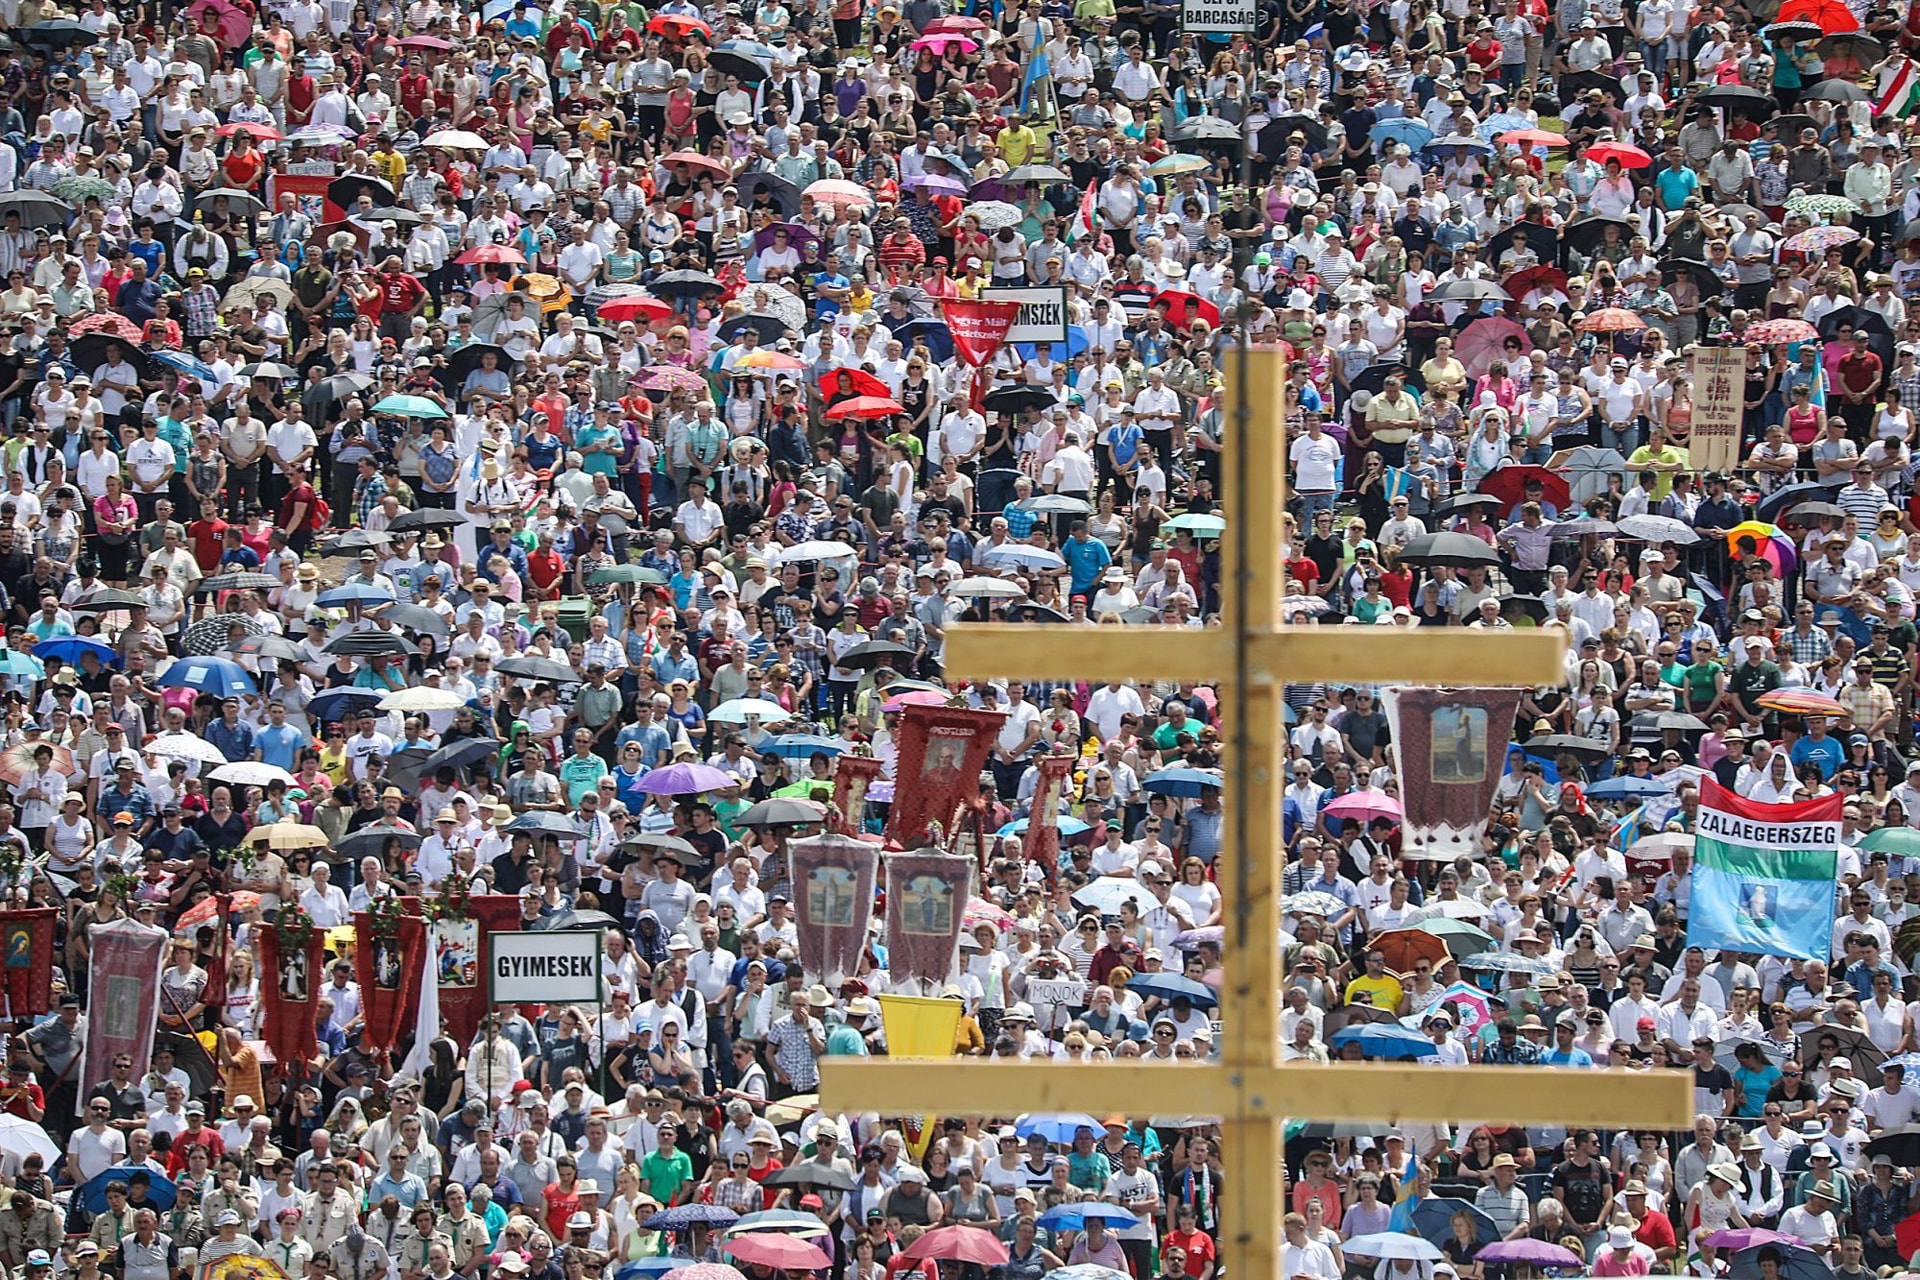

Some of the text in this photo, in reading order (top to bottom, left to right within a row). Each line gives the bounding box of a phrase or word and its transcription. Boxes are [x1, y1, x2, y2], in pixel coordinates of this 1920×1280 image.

[1186, 8, 1254, 25] BARCASÁG
[1701, 812, 1836, 845] ZALAEGERSZEG
[498, 956, 593, 978] GYIMESEK
[1033, 984, 1080, 1001] MONOK
